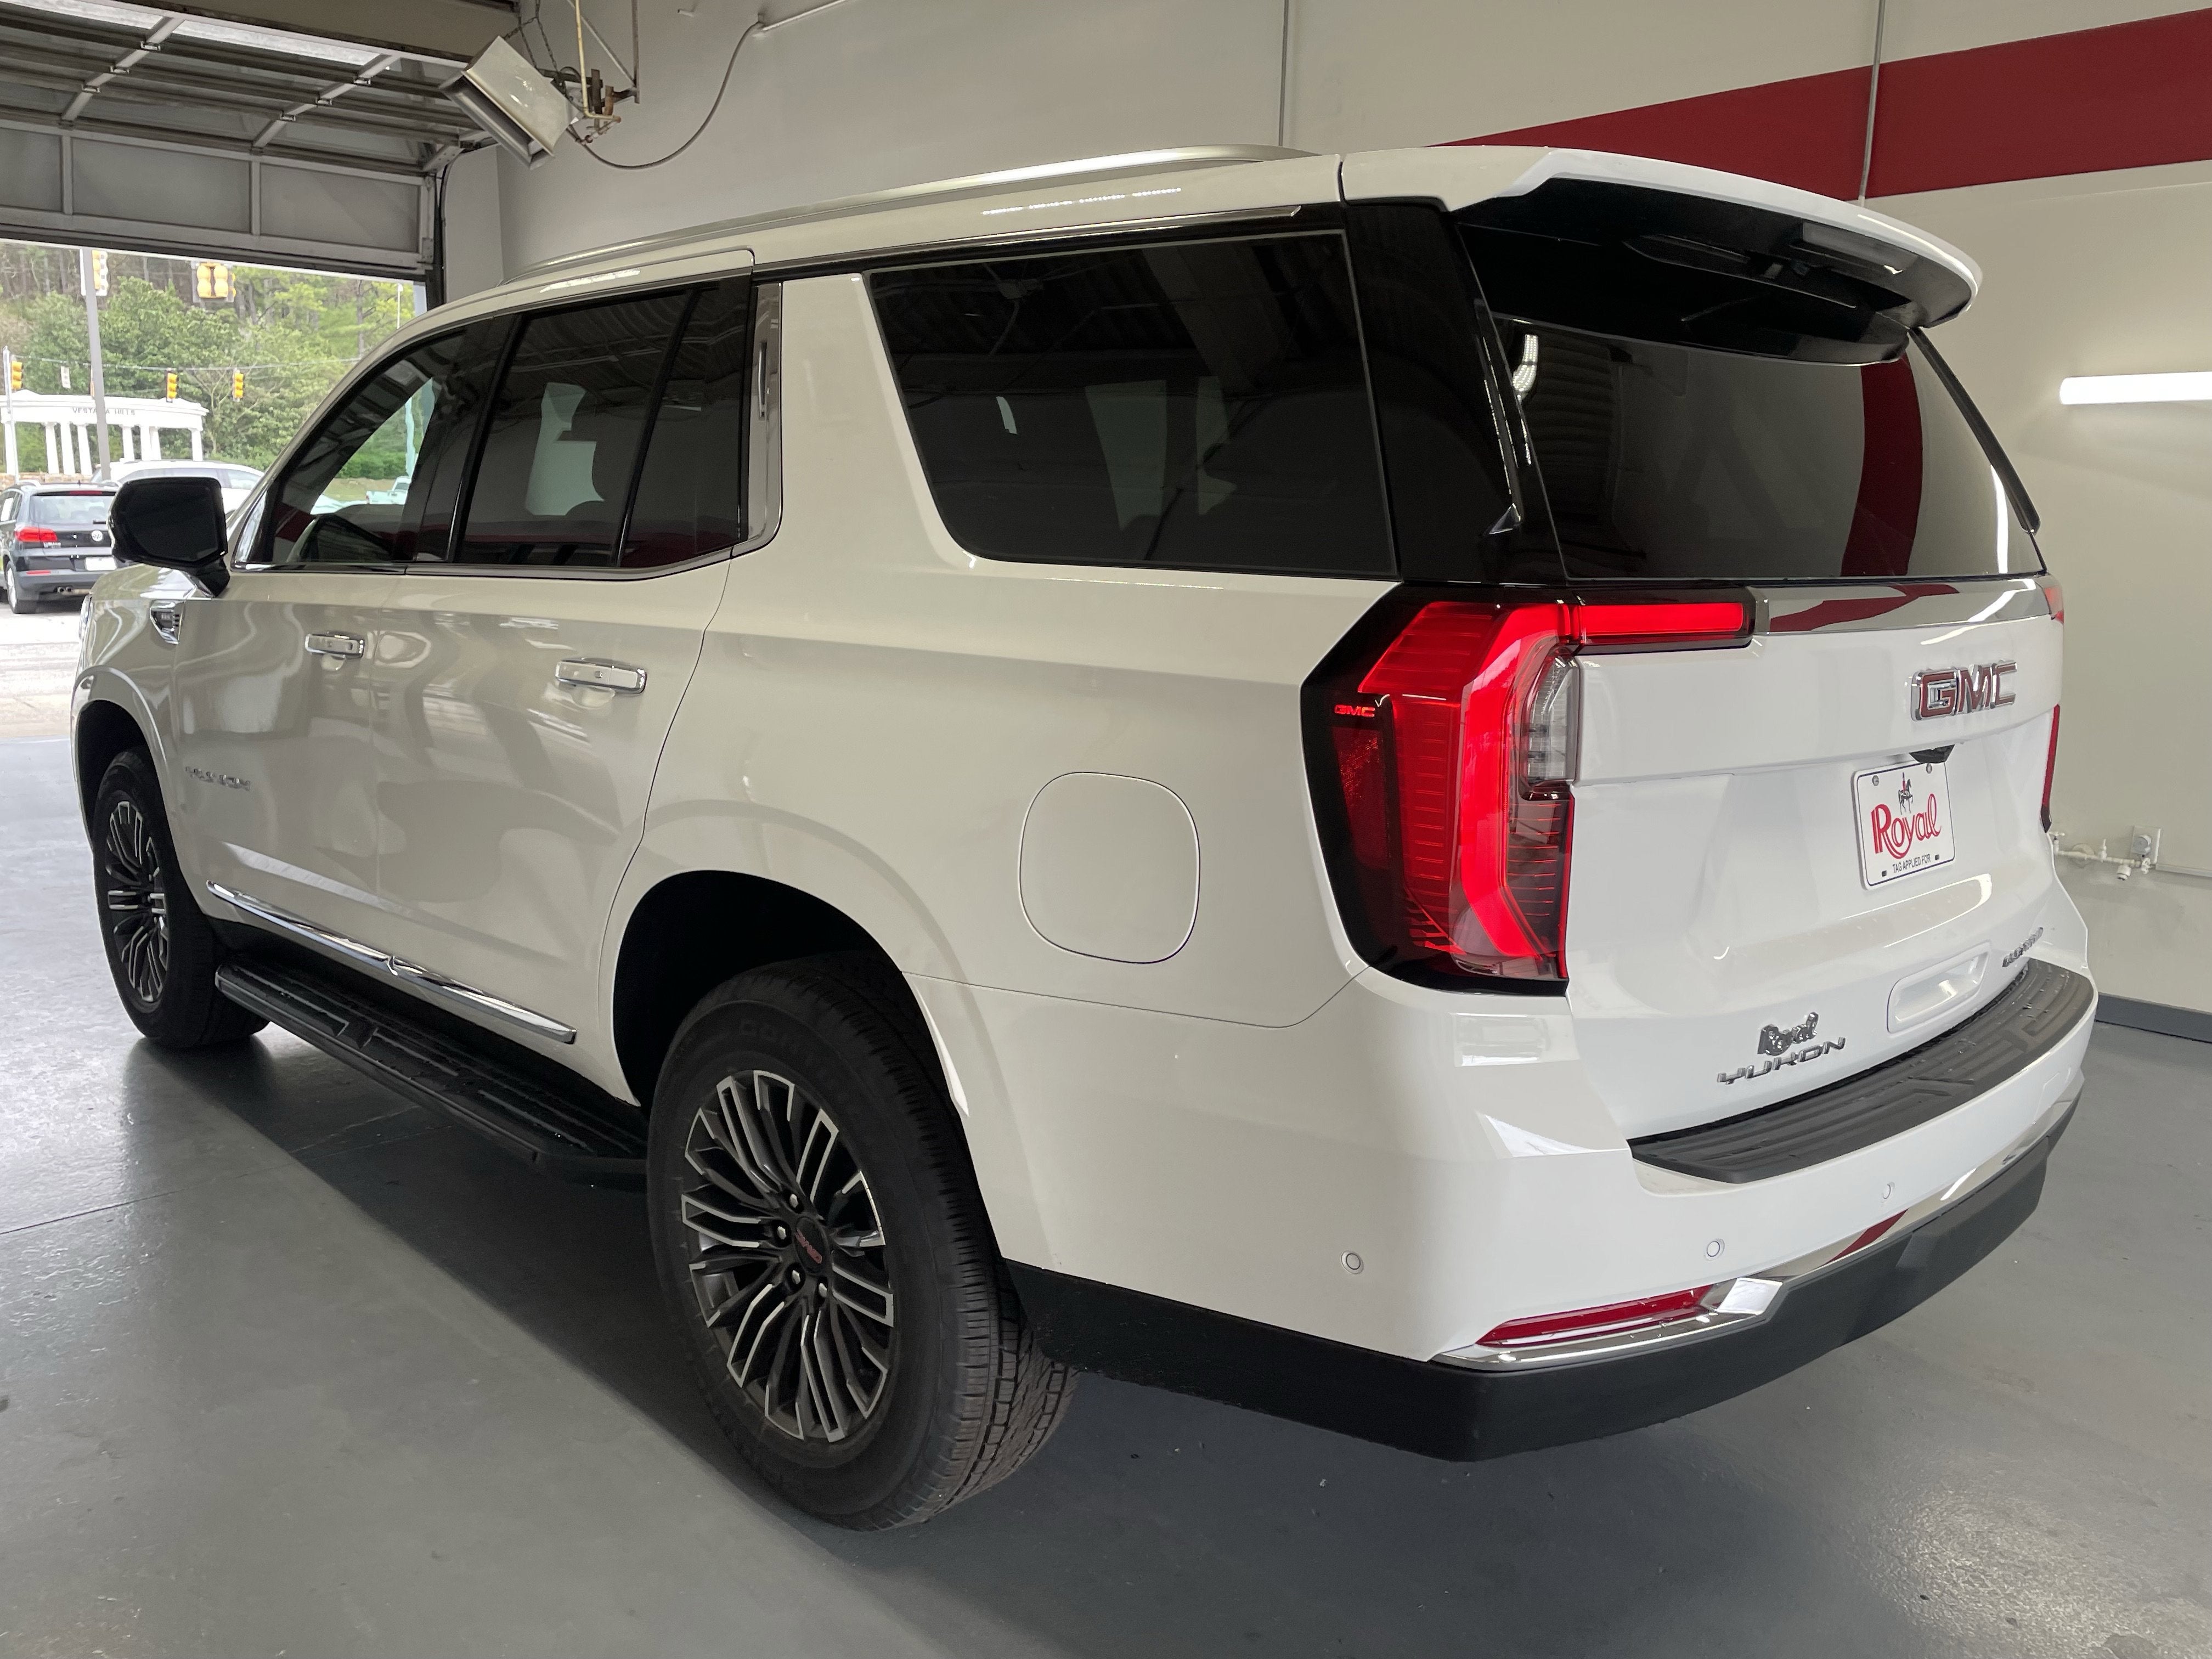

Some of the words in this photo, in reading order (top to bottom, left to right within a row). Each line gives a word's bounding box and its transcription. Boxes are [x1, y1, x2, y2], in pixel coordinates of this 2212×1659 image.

[1334, 704, 1375, 717] GMC
[1911, 660, 2017, 721] GMC
[1871, 793, 1942, 860] Royal
[1892, 862, 1902, 873] TAG
[1903, 856, 1921, 870] APPLIED
[1921, 853, 1931, 865] FOR
[1717, 1036, 1846, 1085] YUKON
